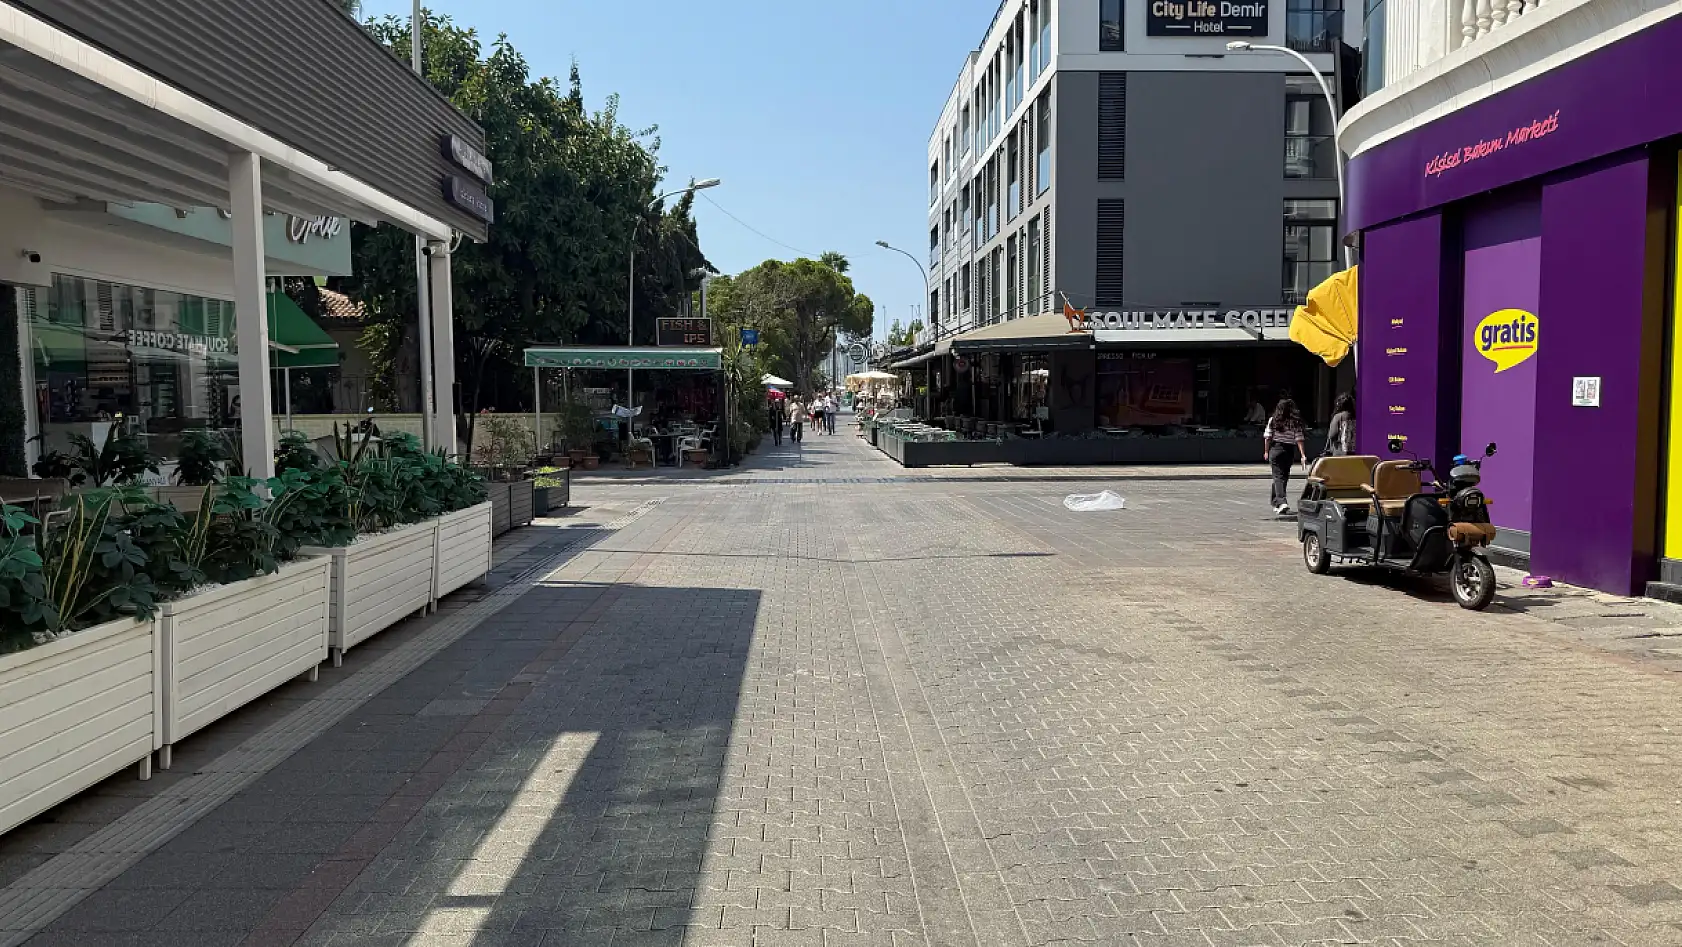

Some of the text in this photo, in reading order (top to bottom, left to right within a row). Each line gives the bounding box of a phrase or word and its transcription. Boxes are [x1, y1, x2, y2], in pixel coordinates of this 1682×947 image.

[1152, 1, 1265, 20] City Life Demir
[1194, 21, 1224, 32] Hotel
[661, 320, 692, 331] FISH
[1090, 310, 1216, 329] SOULMATE
[1481, 315, 1535, 351] gratis
